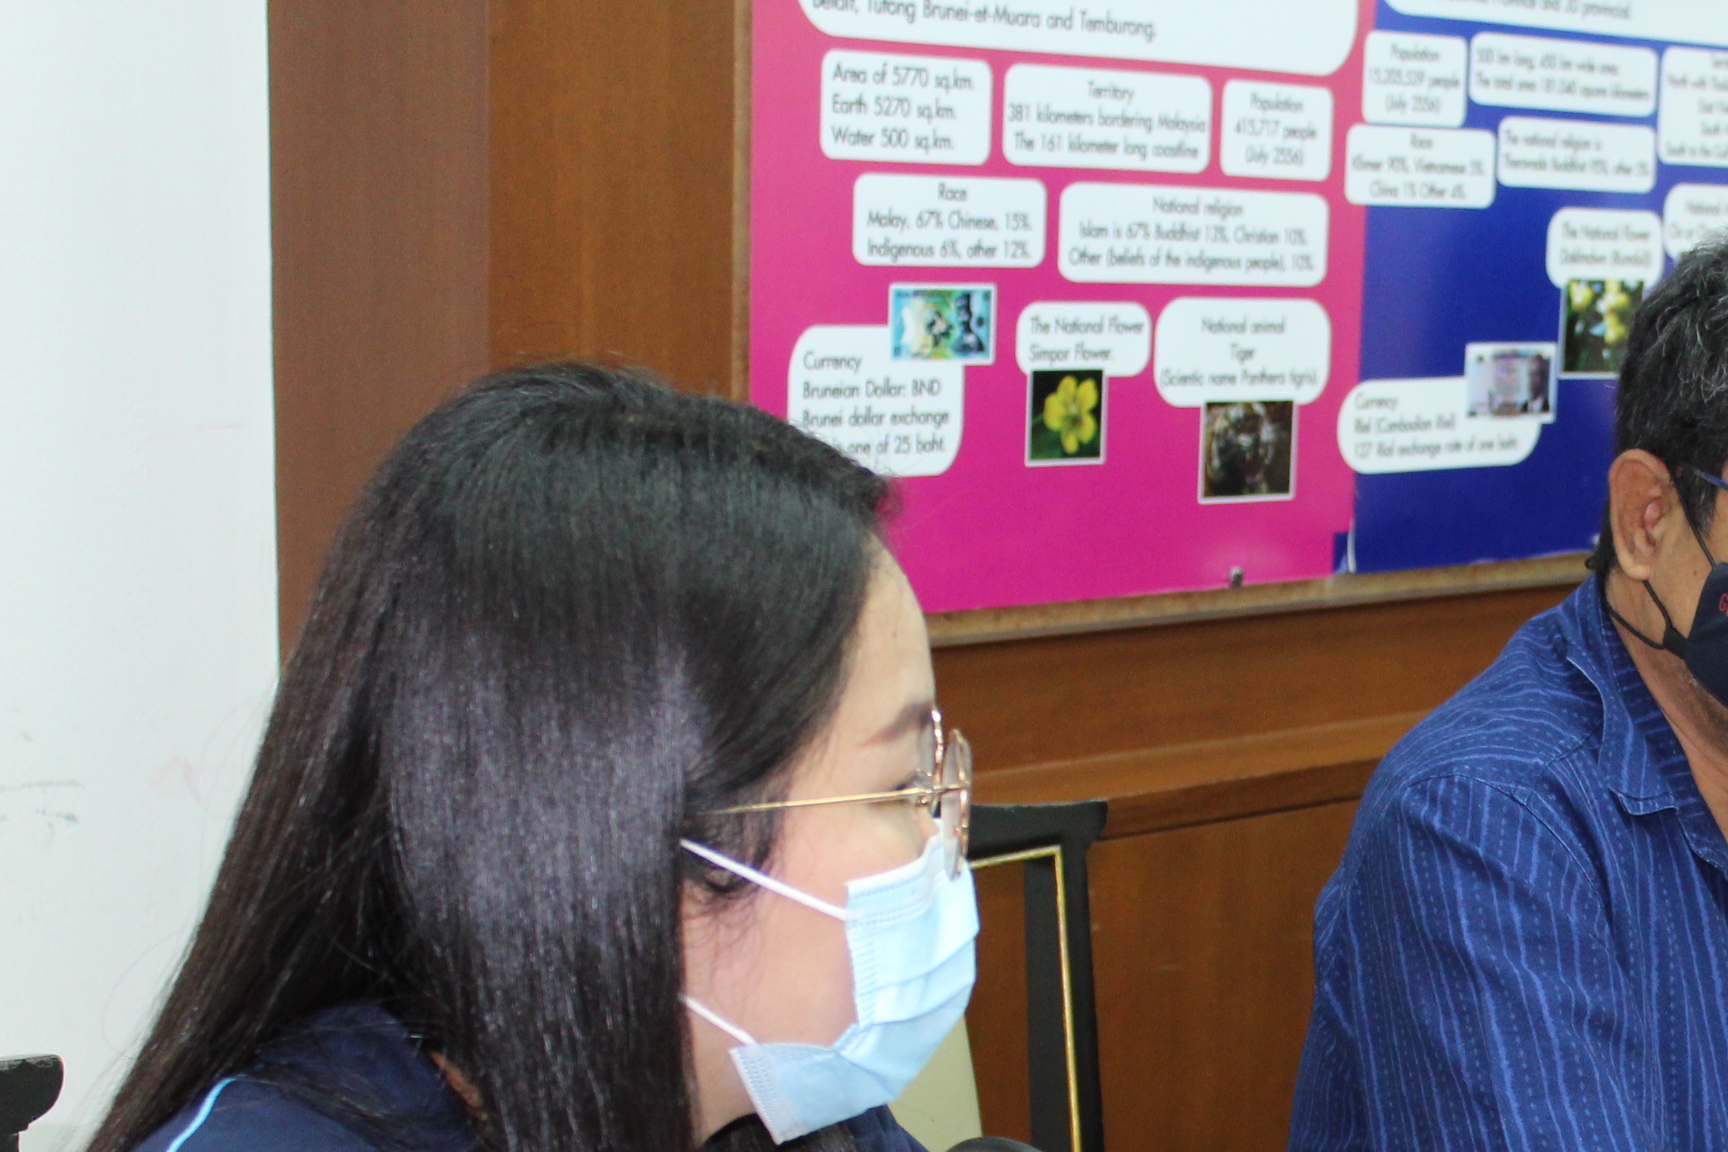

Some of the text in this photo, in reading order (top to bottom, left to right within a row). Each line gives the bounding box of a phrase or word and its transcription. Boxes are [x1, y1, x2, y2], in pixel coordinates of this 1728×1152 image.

[833, 62, 867, 84] Area
[873, 62, 888, 84] of
[892, 65, 929, 87] 5770
[832, 92, 867, 115] Earth
[874, 96, 910, 117] 5270
[1088, 79, 1135, 106] Territory
[1250, 92, 1304, 118] Population
[1007, 101, 1206, 135] 381 kilometers bordering Malaysia
[831, 125, 875, 147] Water
[881, 127, 909, 149] 500
[1013, 131, 1198, 161] The 161 kilometer long coastline
[938, 181, 967, 201] Race
[1153, 196, 1243, 221] National religion
[1079, 219, 1108, 239] Islam
[1154, 222, 1200, 242] Buddhist
[1233, 224, 1279, 244] Christian
[867, 237, 934, 263] Indigenous
[967, 238, 997, 258] other
[1030, 314, 1146, 335] The National Flower
[1201, 315, 1286, 335] National animal
[803, 351, 862, 374] Currency
[1029, 342, 1070, 366] Simpor
[1230, 342, 1255, 366] Tiger
[803, 380, 859, 399] Bruneian
[912, 379, 941, 397] BND
[1354, 392, 1399, 412] Currency
[802, 405, 949, 429] Brunei dollar exchange
[849, 442, 871, 455] one
[876, 433, 889, 454] of
[894, 435, 910, 454] 25
